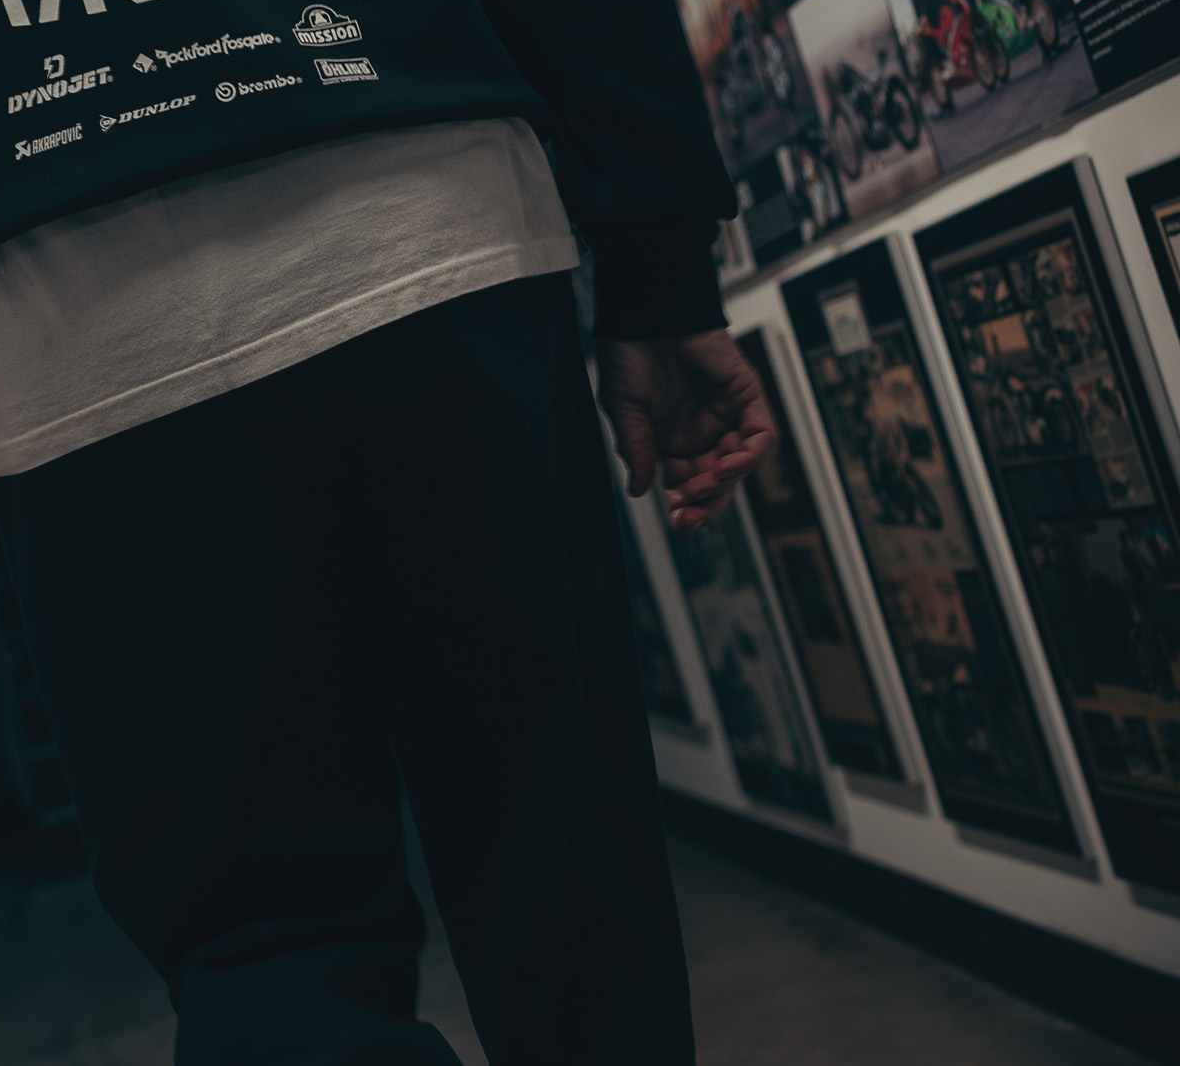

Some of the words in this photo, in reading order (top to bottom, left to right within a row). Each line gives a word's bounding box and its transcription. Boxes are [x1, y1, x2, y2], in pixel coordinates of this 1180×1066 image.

[7, 66, 111, 114] DYNOJET
[238, 74, 296, 95] brembo
[117, 94, 197, 124] DUNLOP
